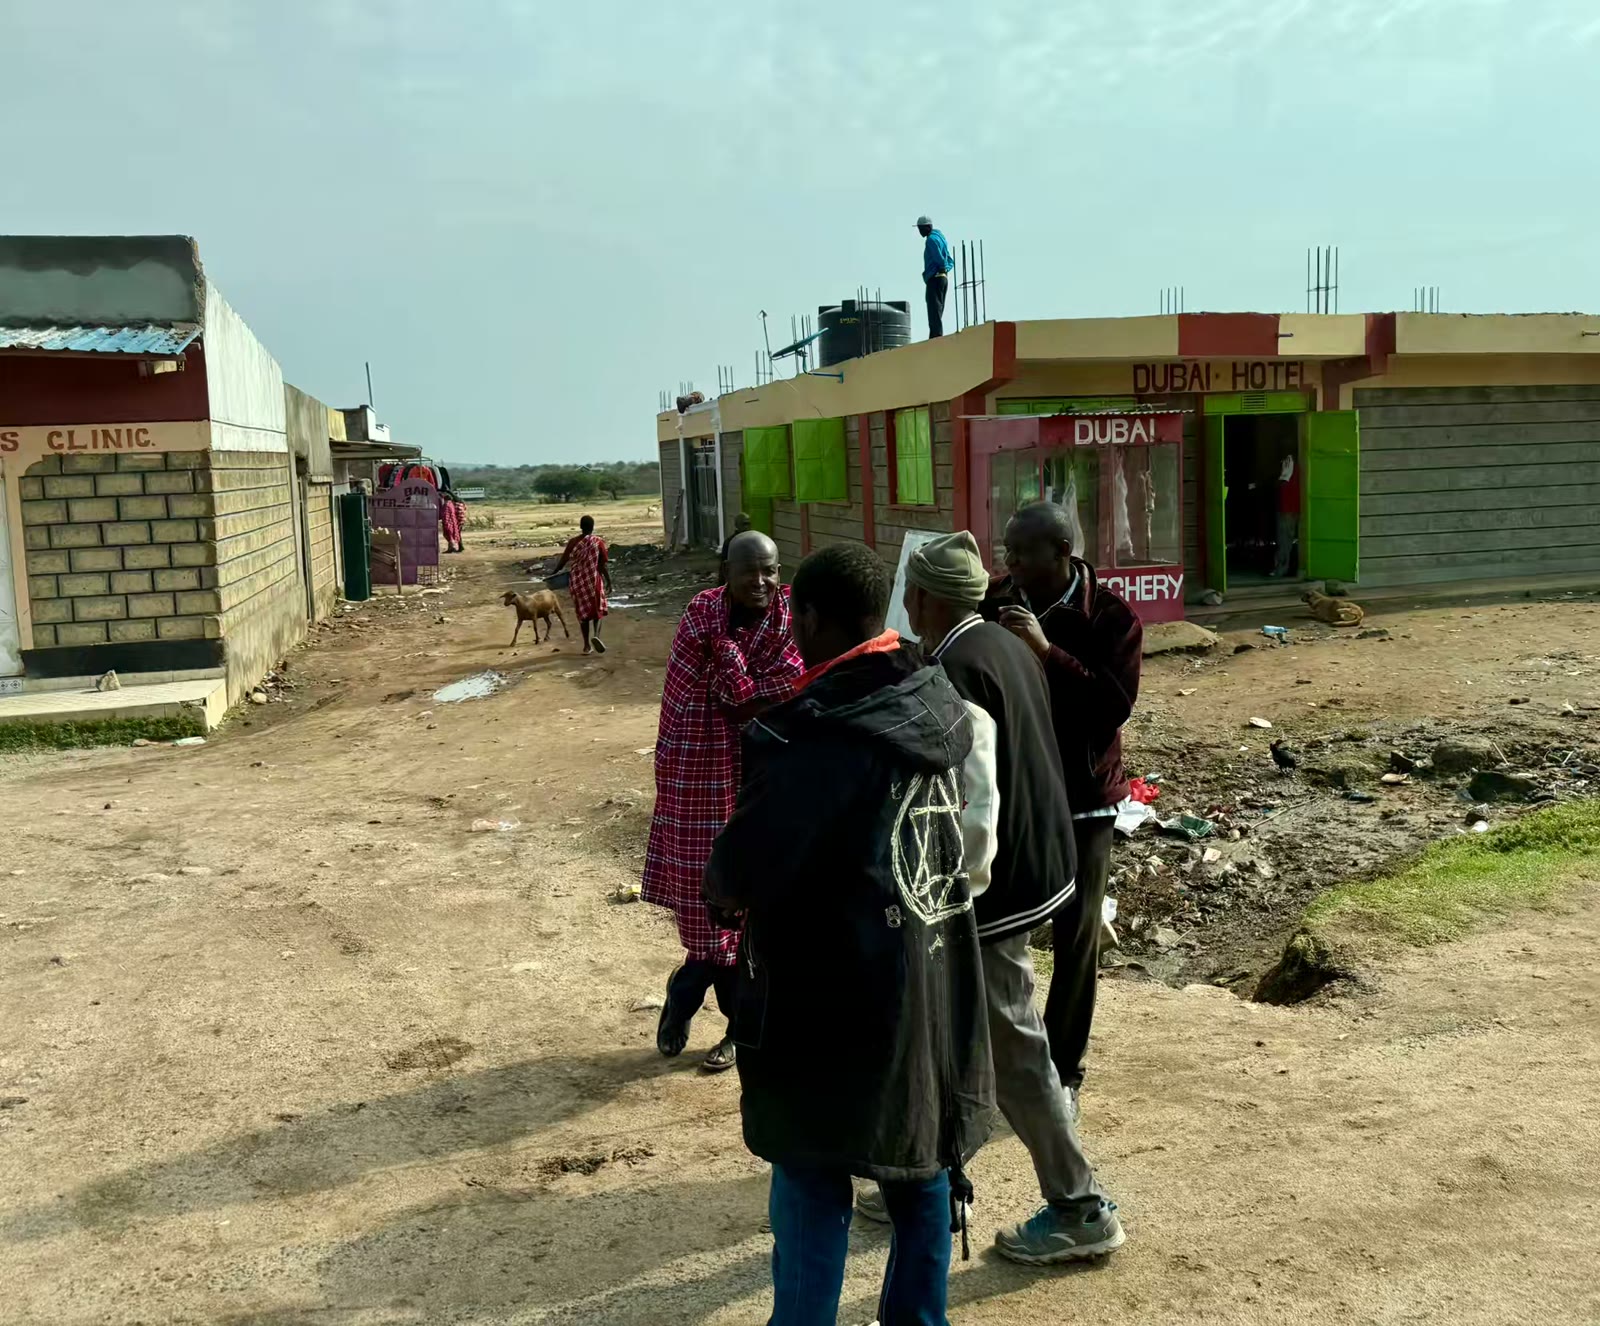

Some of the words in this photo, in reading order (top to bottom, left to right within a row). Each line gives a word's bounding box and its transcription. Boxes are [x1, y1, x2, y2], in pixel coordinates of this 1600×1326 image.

[1132, 363, 1211, 393] DUBAI
[1231, 361, 1307, 391] HOTEL
[46, 427, 157, 450] CLINIC.
[1074, 418, 1156, 445] DUBAI
[404, 486, 429, 497] BAR
